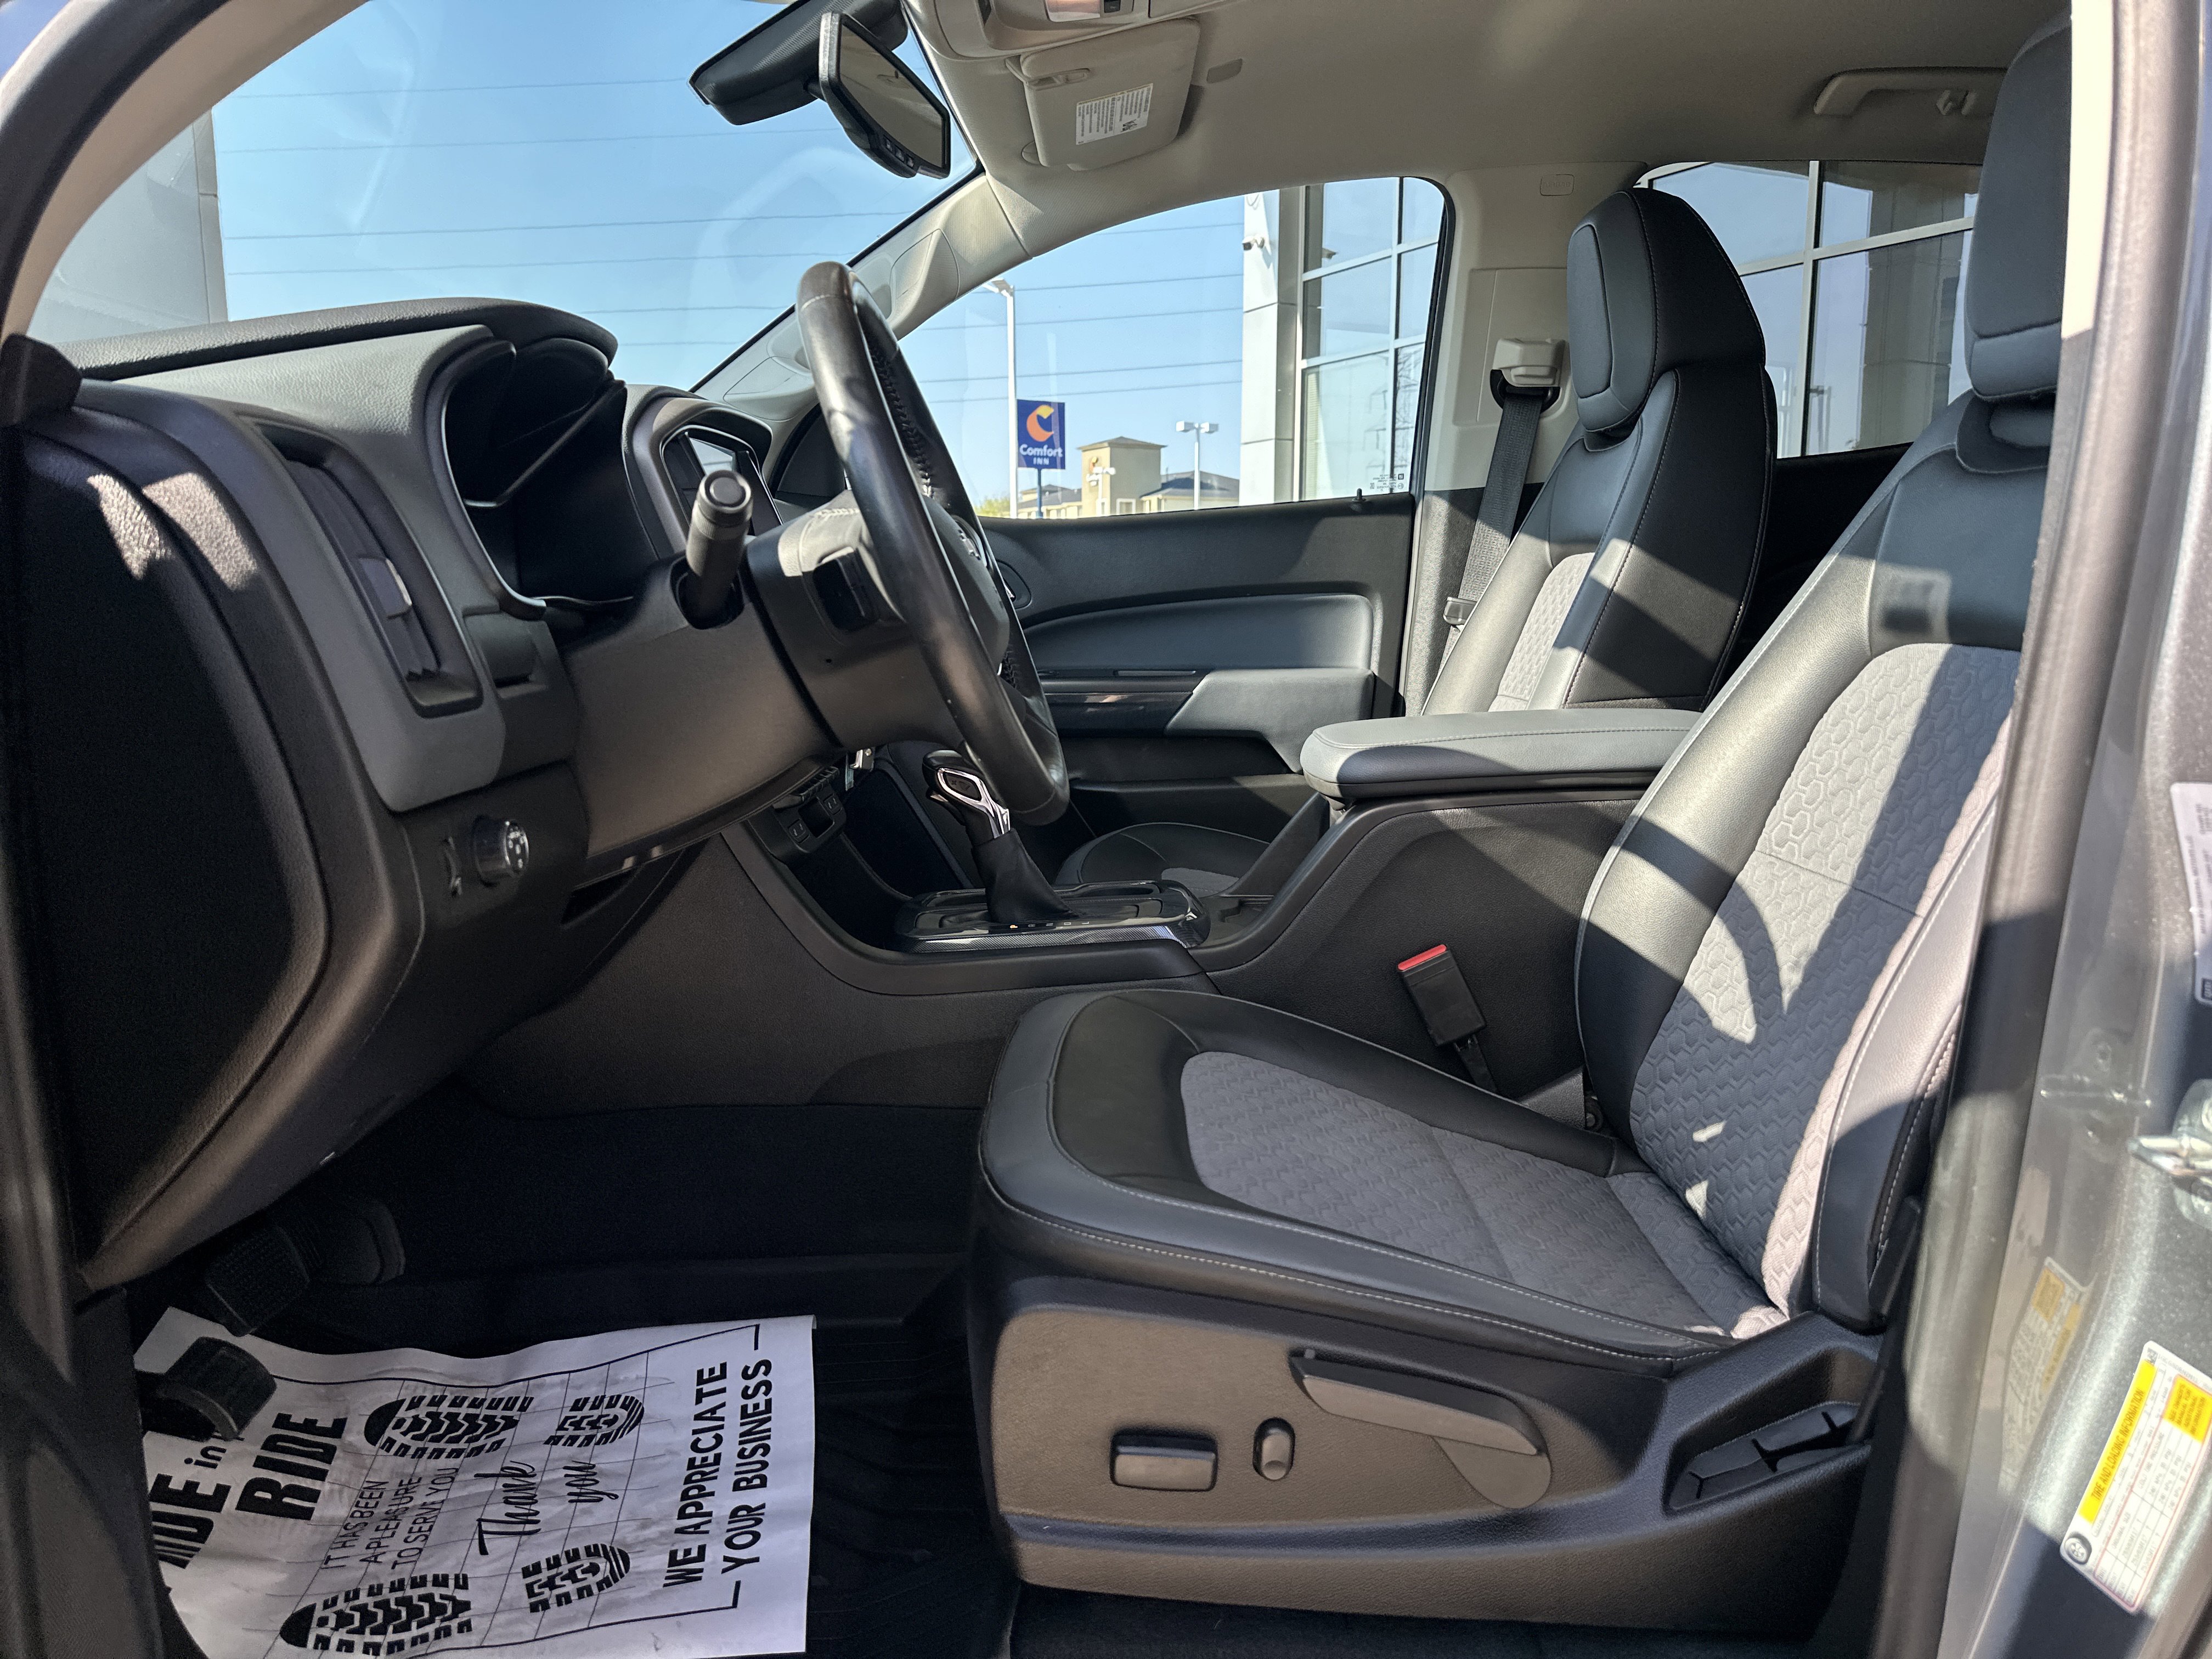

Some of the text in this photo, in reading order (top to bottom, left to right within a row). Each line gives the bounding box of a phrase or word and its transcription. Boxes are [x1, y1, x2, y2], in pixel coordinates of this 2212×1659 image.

[1019, 444, 1063, 457] Comfort
[184, 1445, 227, 1469] in
[235, 1412, 348, 1521] RIDE
[563, 1460, 619, 1503] you
[663, 1361, 727, 1588] WE APPRECIATE
[721, 1358, 772, 1574] YOUR BUSINESS
[2091, 1482, 2102, 1501] TIRE
[2100, 1464, 2112, 1485] AND
[2107, 1435, 2125, 1470] LOADING
[2119, 1387, 2145, 1438] INFORMATION
[320, 1481, 389, 1570] IT HAS BEEN
[359, 1476, 422, 1564] A PLEASURE
[391, 1467, 459, 1570] TO SERVE YOU
[474, 1460, 541, 1555] Thank
